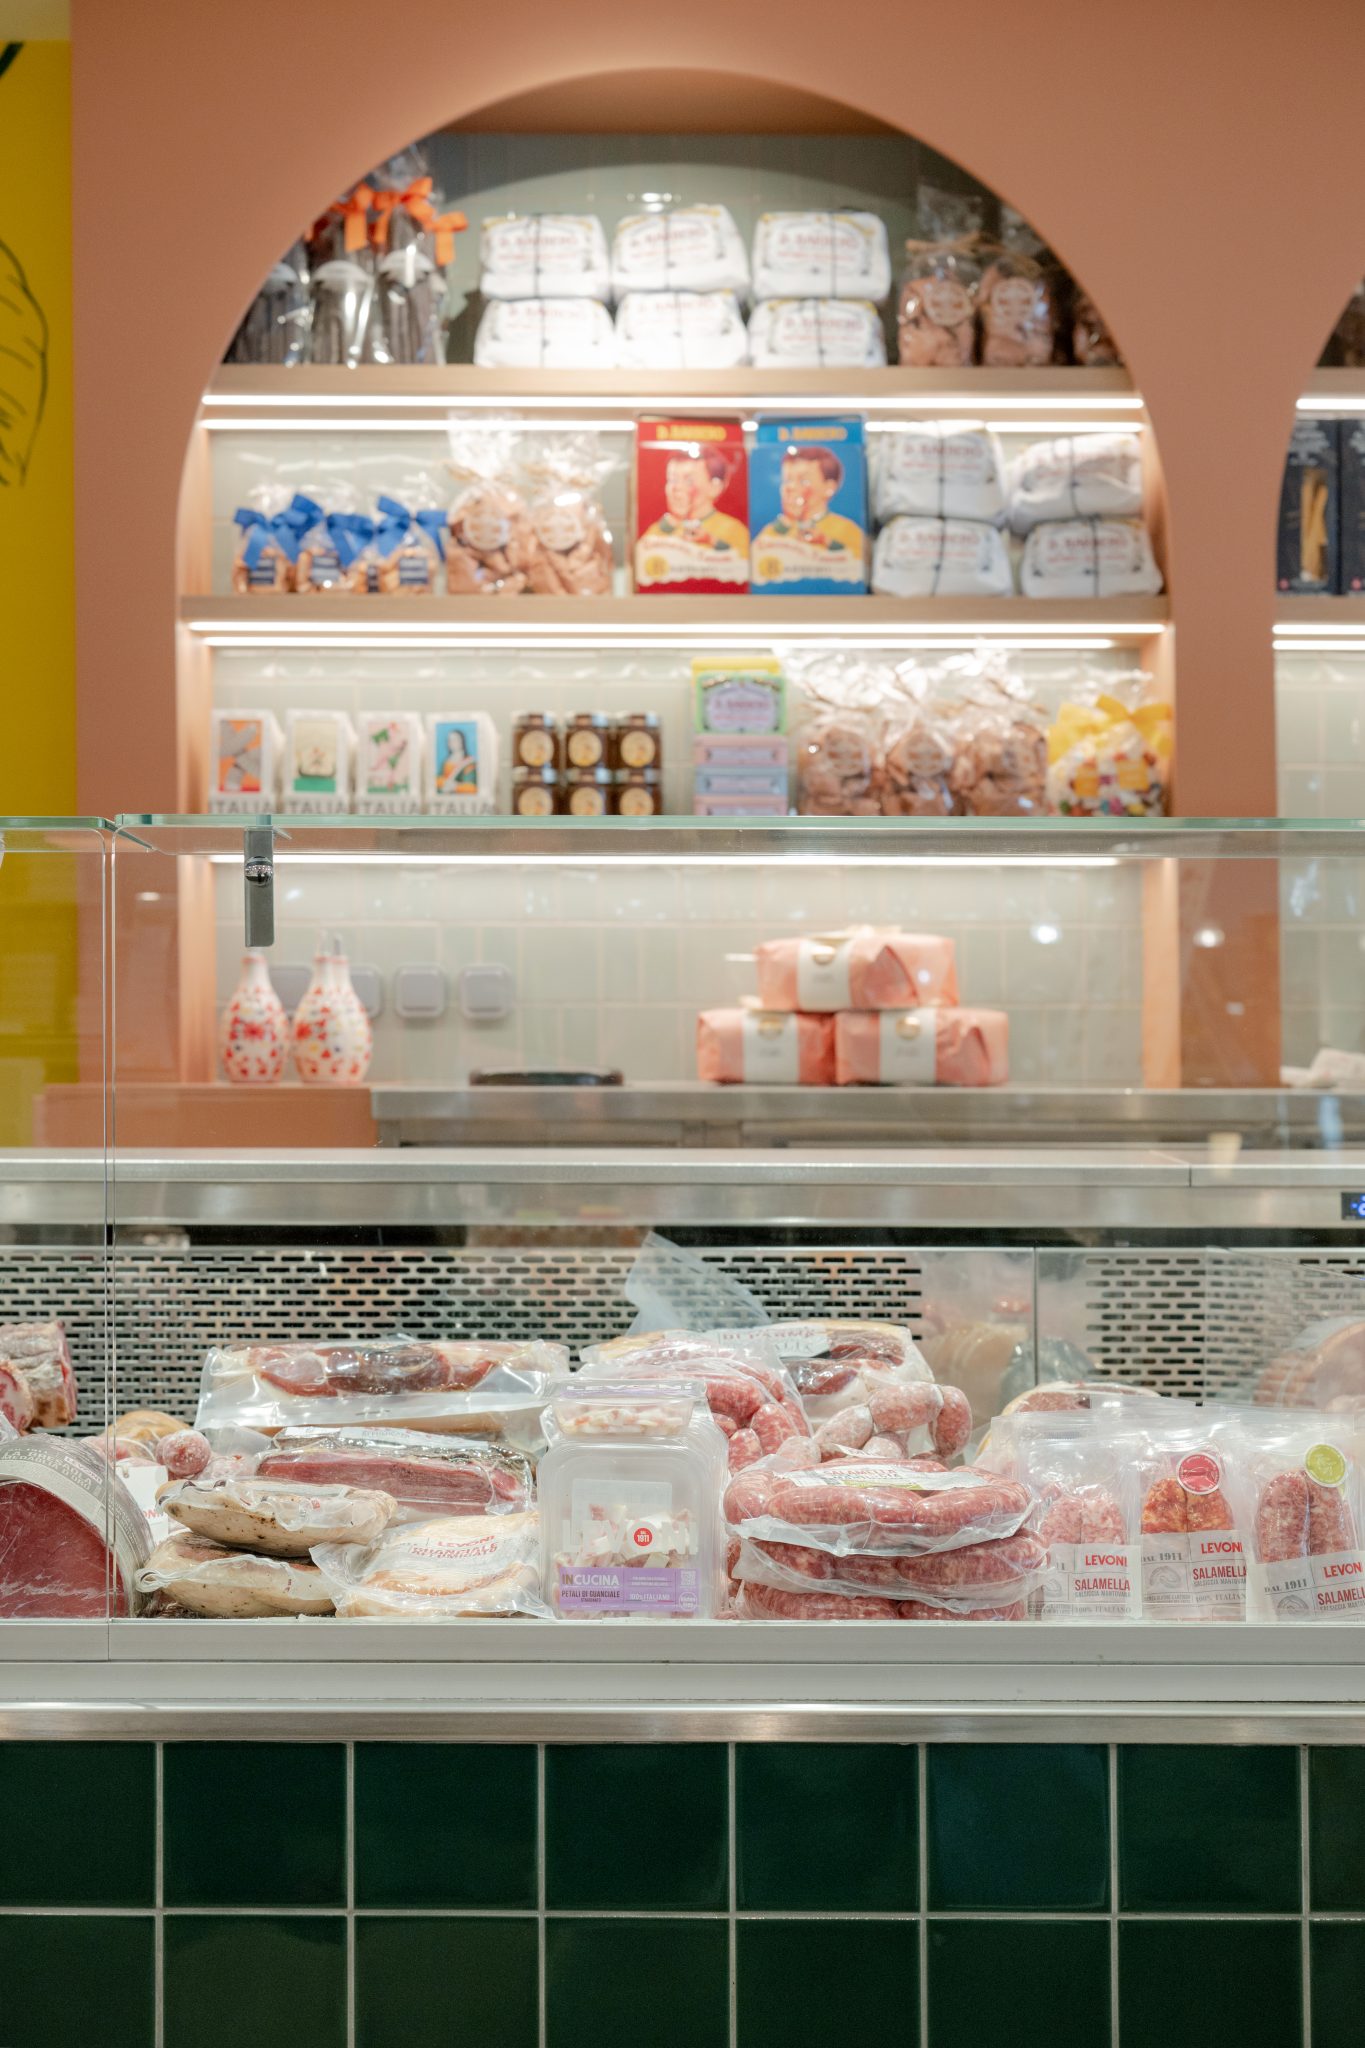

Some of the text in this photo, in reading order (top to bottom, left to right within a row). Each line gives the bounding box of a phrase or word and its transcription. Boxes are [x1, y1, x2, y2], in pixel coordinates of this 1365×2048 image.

[1085, 1554, 1128, 1567] LEVONI
[1159, 1552, 1182, 1561] 1911
[1074, 1577, 1131, 1592] SALAMELLA
[1264, 1578, 1307, 1593] DAL 1911
